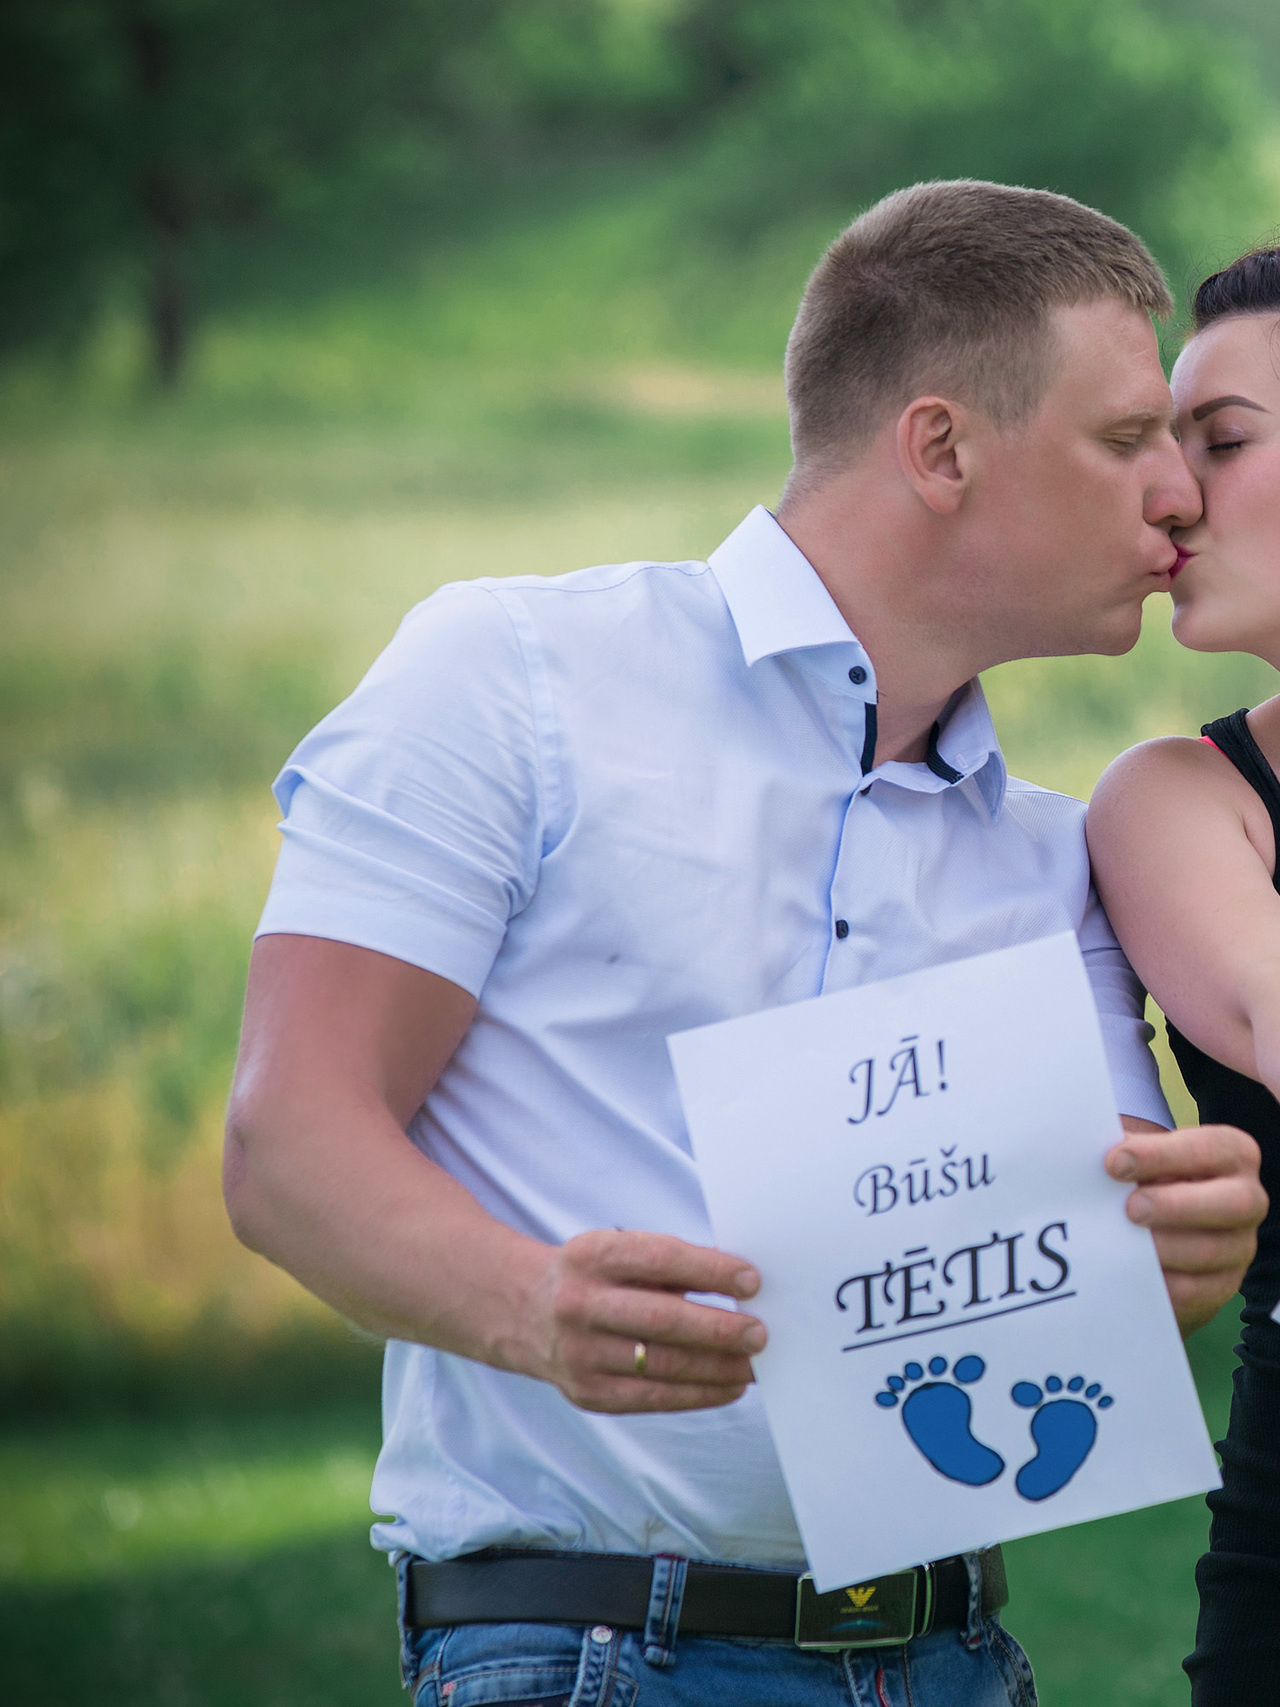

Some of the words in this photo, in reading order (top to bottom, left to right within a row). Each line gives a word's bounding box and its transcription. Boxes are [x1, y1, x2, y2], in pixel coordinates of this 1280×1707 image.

[846, 1034, 949, 1125] JĀ!
[853, 1144, 997, 1217] Būšu
[836, 1221, 1071, 1335] TĒTIS
